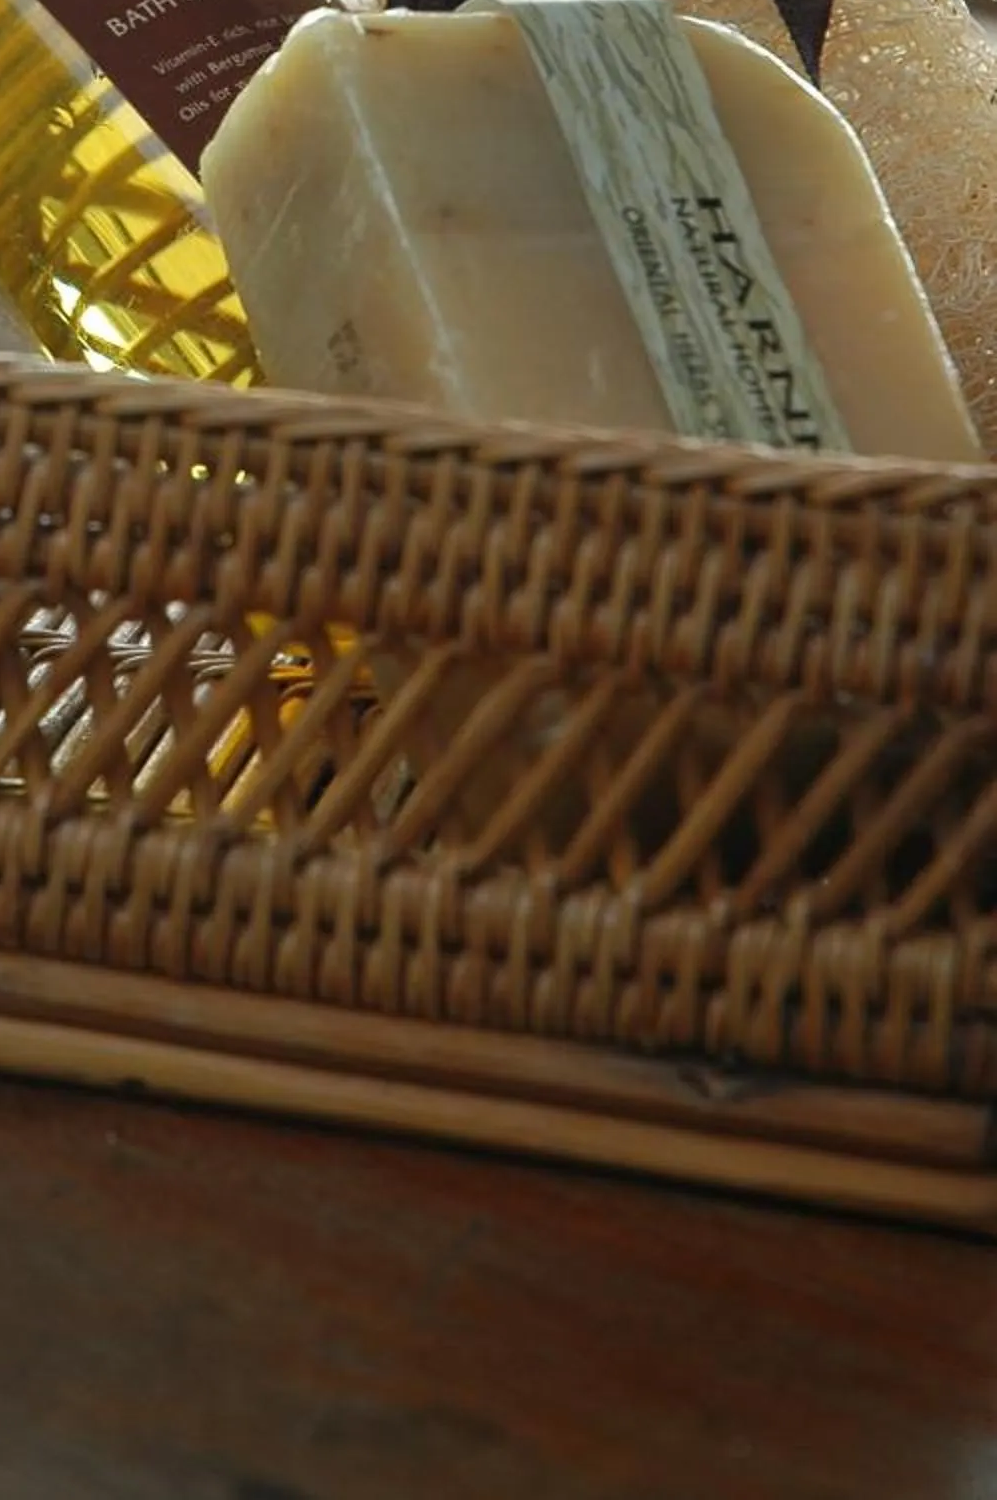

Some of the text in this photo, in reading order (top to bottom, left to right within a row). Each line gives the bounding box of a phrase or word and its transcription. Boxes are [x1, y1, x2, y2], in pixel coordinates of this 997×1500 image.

[174, 70, 208, 94] with
[178, 87, 232, 122] Oils for
[670, 196, 737, 334] NATURAL
